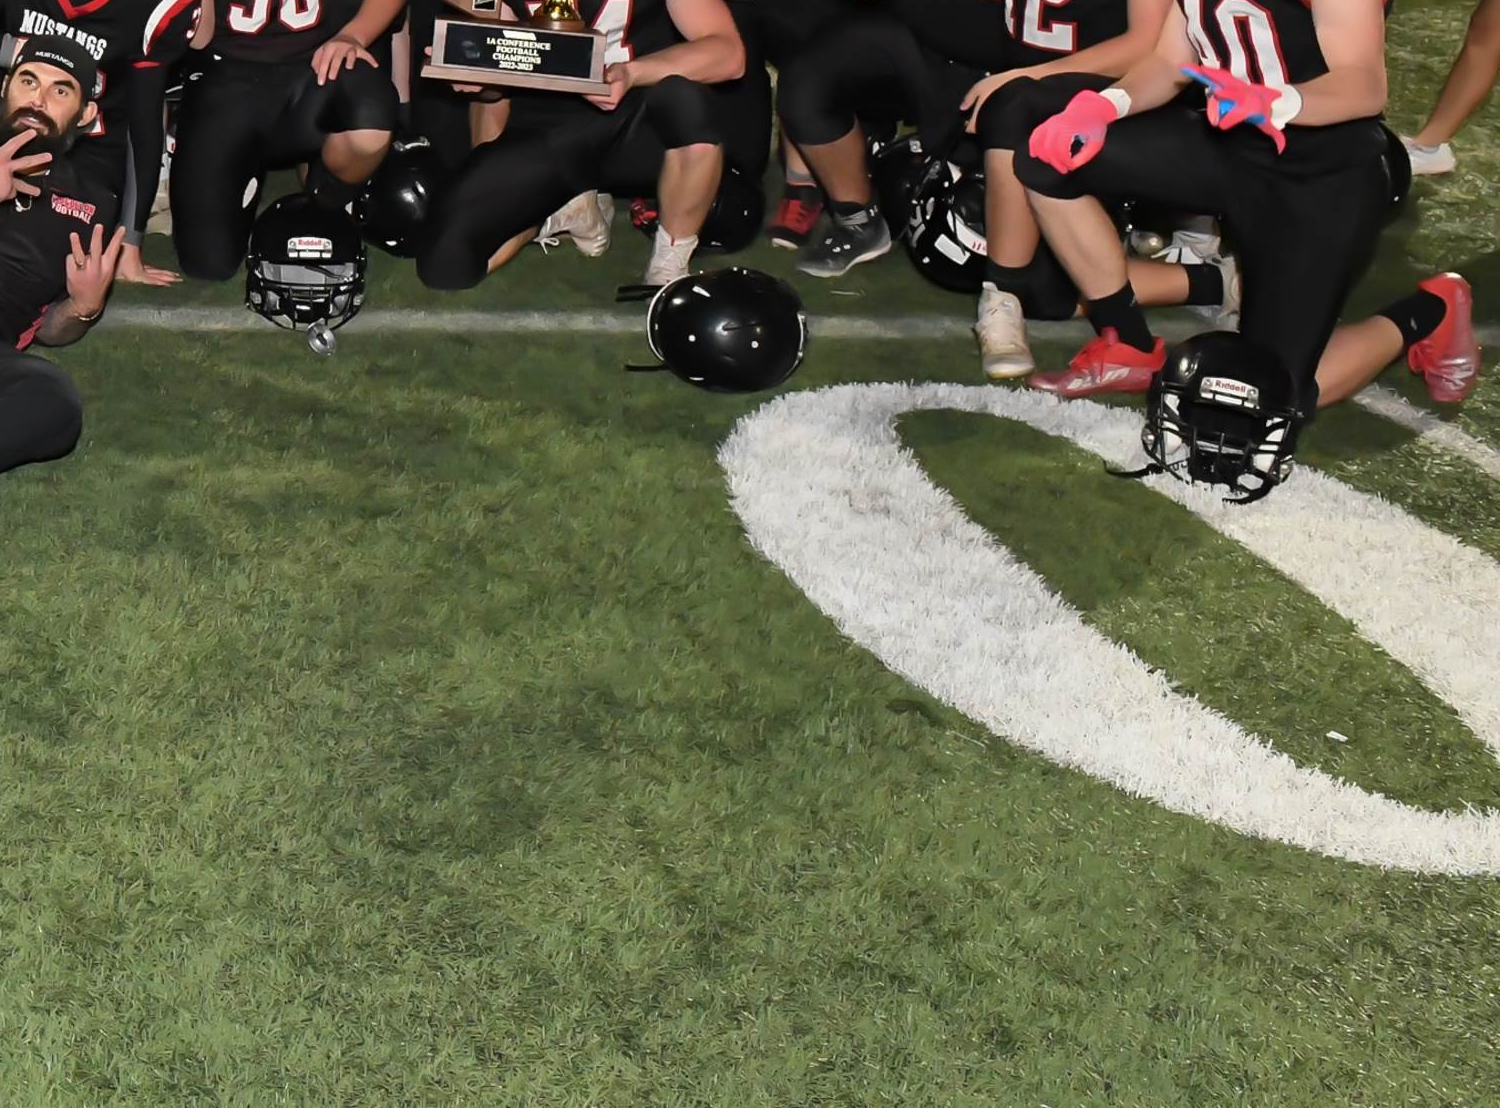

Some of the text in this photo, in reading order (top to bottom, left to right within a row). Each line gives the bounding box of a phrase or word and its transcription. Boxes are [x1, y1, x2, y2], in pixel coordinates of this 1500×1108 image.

[19, 8, 108, 61] MUSTANGS
[495, 46, 539, 57] FOOTBALL
[497, 39, 551, 51] CONFERENCE
[34, 50, 75, 69] MUSTANGS
[492, 53, 541, 64] CHAMPIONS
[51, 202, 93, 225] FOOTBALL
[1214, 379, 1248, 393] Riddell
